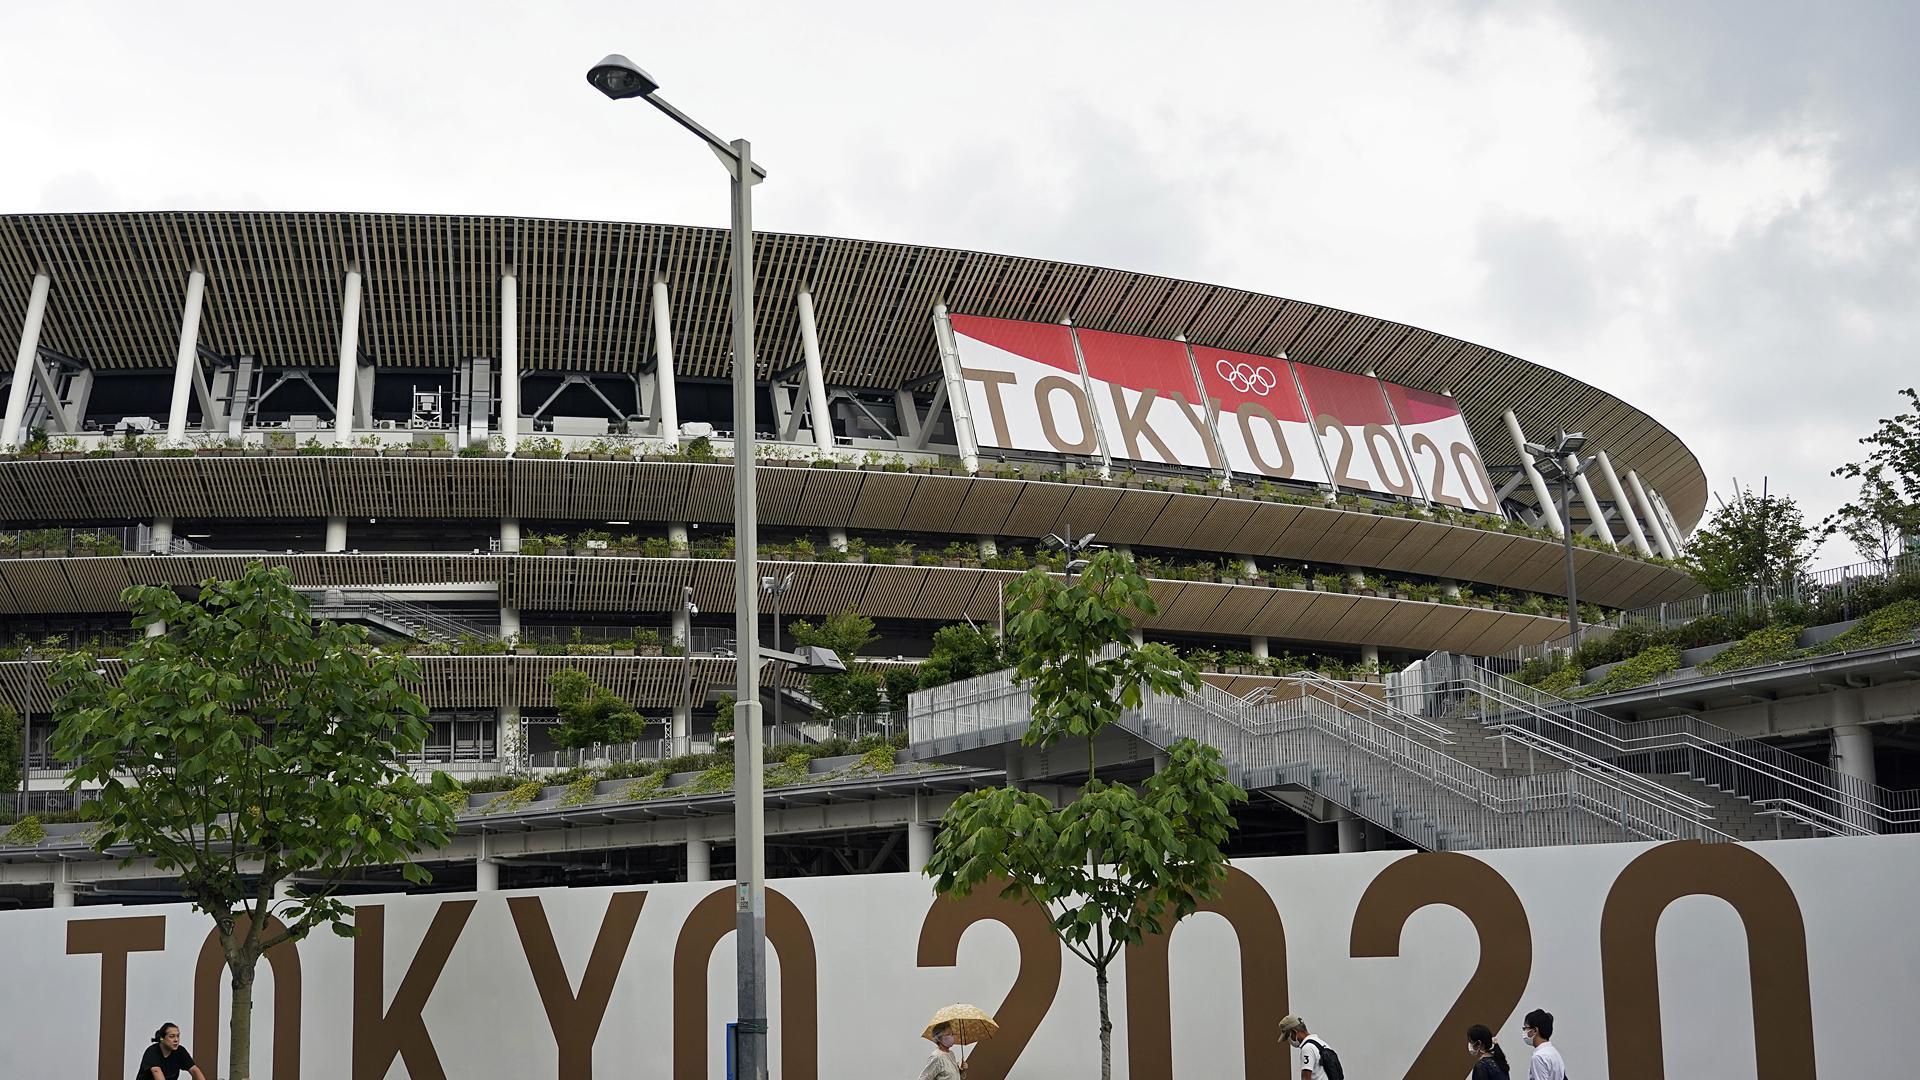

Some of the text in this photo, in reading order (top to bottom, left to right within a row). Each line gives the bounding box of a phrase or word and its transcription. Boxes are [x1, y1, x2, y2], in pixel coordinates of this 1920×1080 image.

[962, 368, 1498, 513] TOKYO 2020
[66, 839, 1817, 1080] TOKYO 2020
[1303, 1055, 1310, 1065] 3
